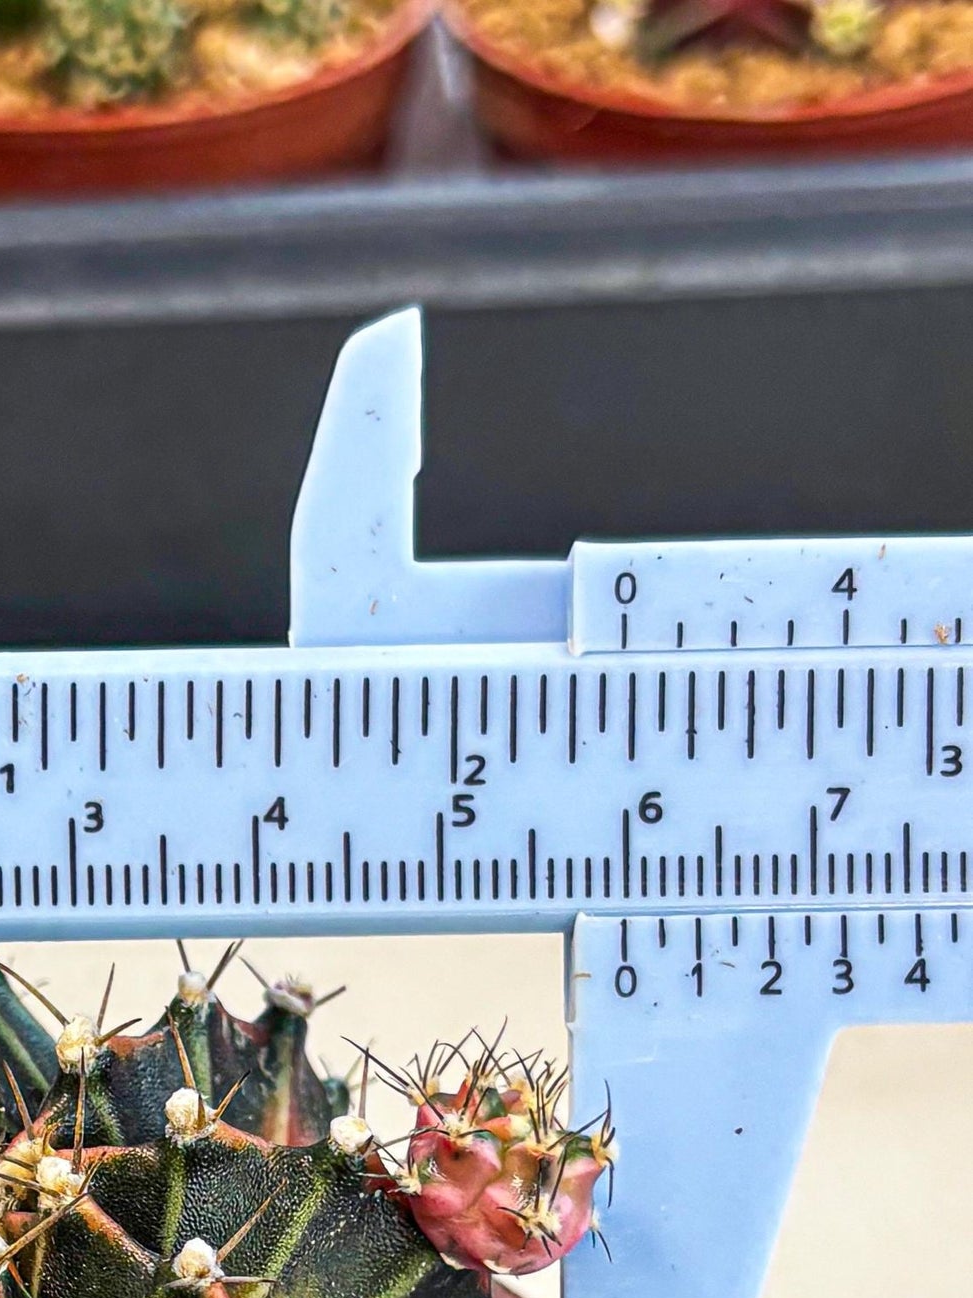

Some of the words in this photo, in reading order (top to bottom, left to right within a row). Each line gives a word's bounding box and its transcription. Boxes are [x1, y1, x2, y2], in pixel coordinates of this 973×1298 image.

[614, 571, 637, 605] 0
[831, 567, 858, 602] 4
[463, 754, 487, 787] 2
[939, 744, 963, 778] 3
[83, 801, 105, 834] 3
[262, 796, 290, 831] 4
[451, 793, 477, 828] 5
[638, 790, 664, 825] 6
[826, 786, 852, 822] 7
[614, 964, 638, 998] 0
[689, 962, 703, 998] 1
[759, 960, 783, 996] 2
[832, 958, 855, 996] 3
[903, 957, 931, 993] 4
